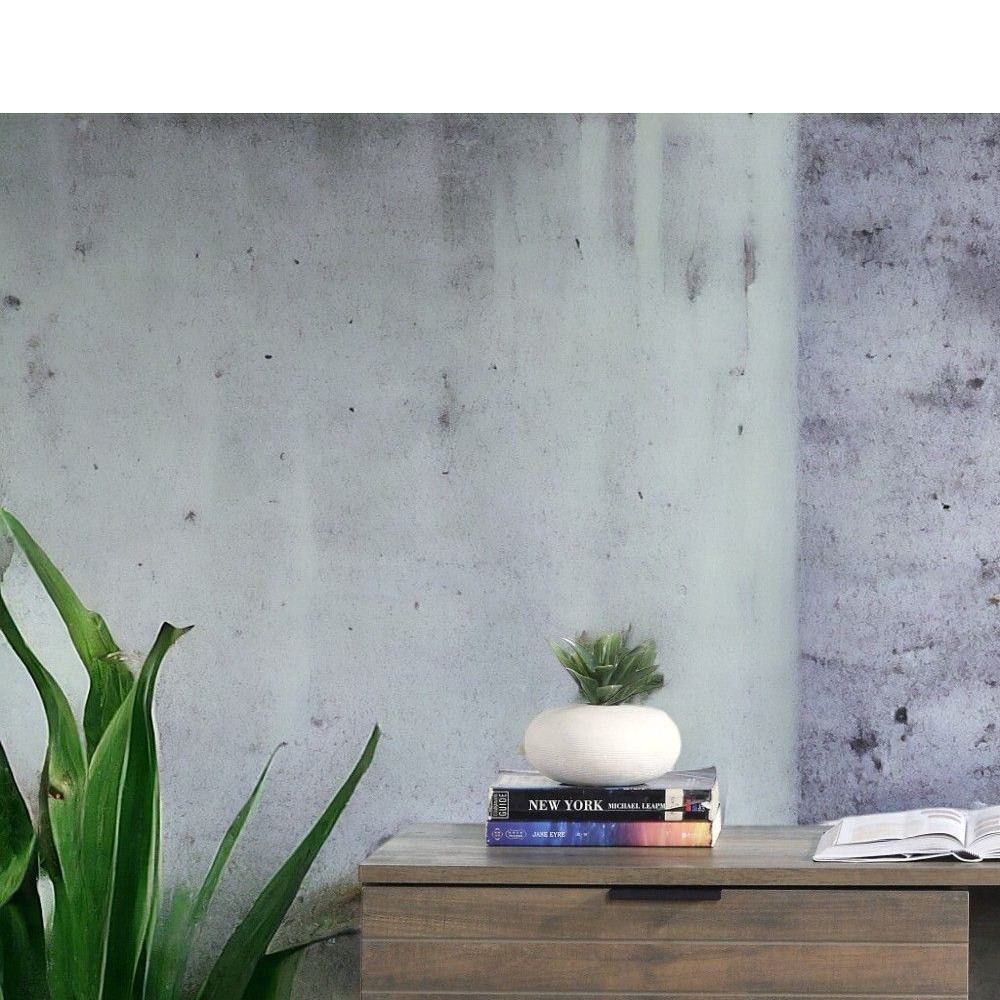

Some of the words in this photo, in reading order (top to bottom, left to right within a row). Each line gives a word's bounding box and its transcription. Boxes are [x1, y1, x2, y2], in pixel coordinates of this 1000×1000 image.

[498, 794, 507, 817] GUIDE
[528, 799, 561, 811] NEW
[564, 799, 604, 811] YORK
[608, 802, 640, 810] MICHAEL
